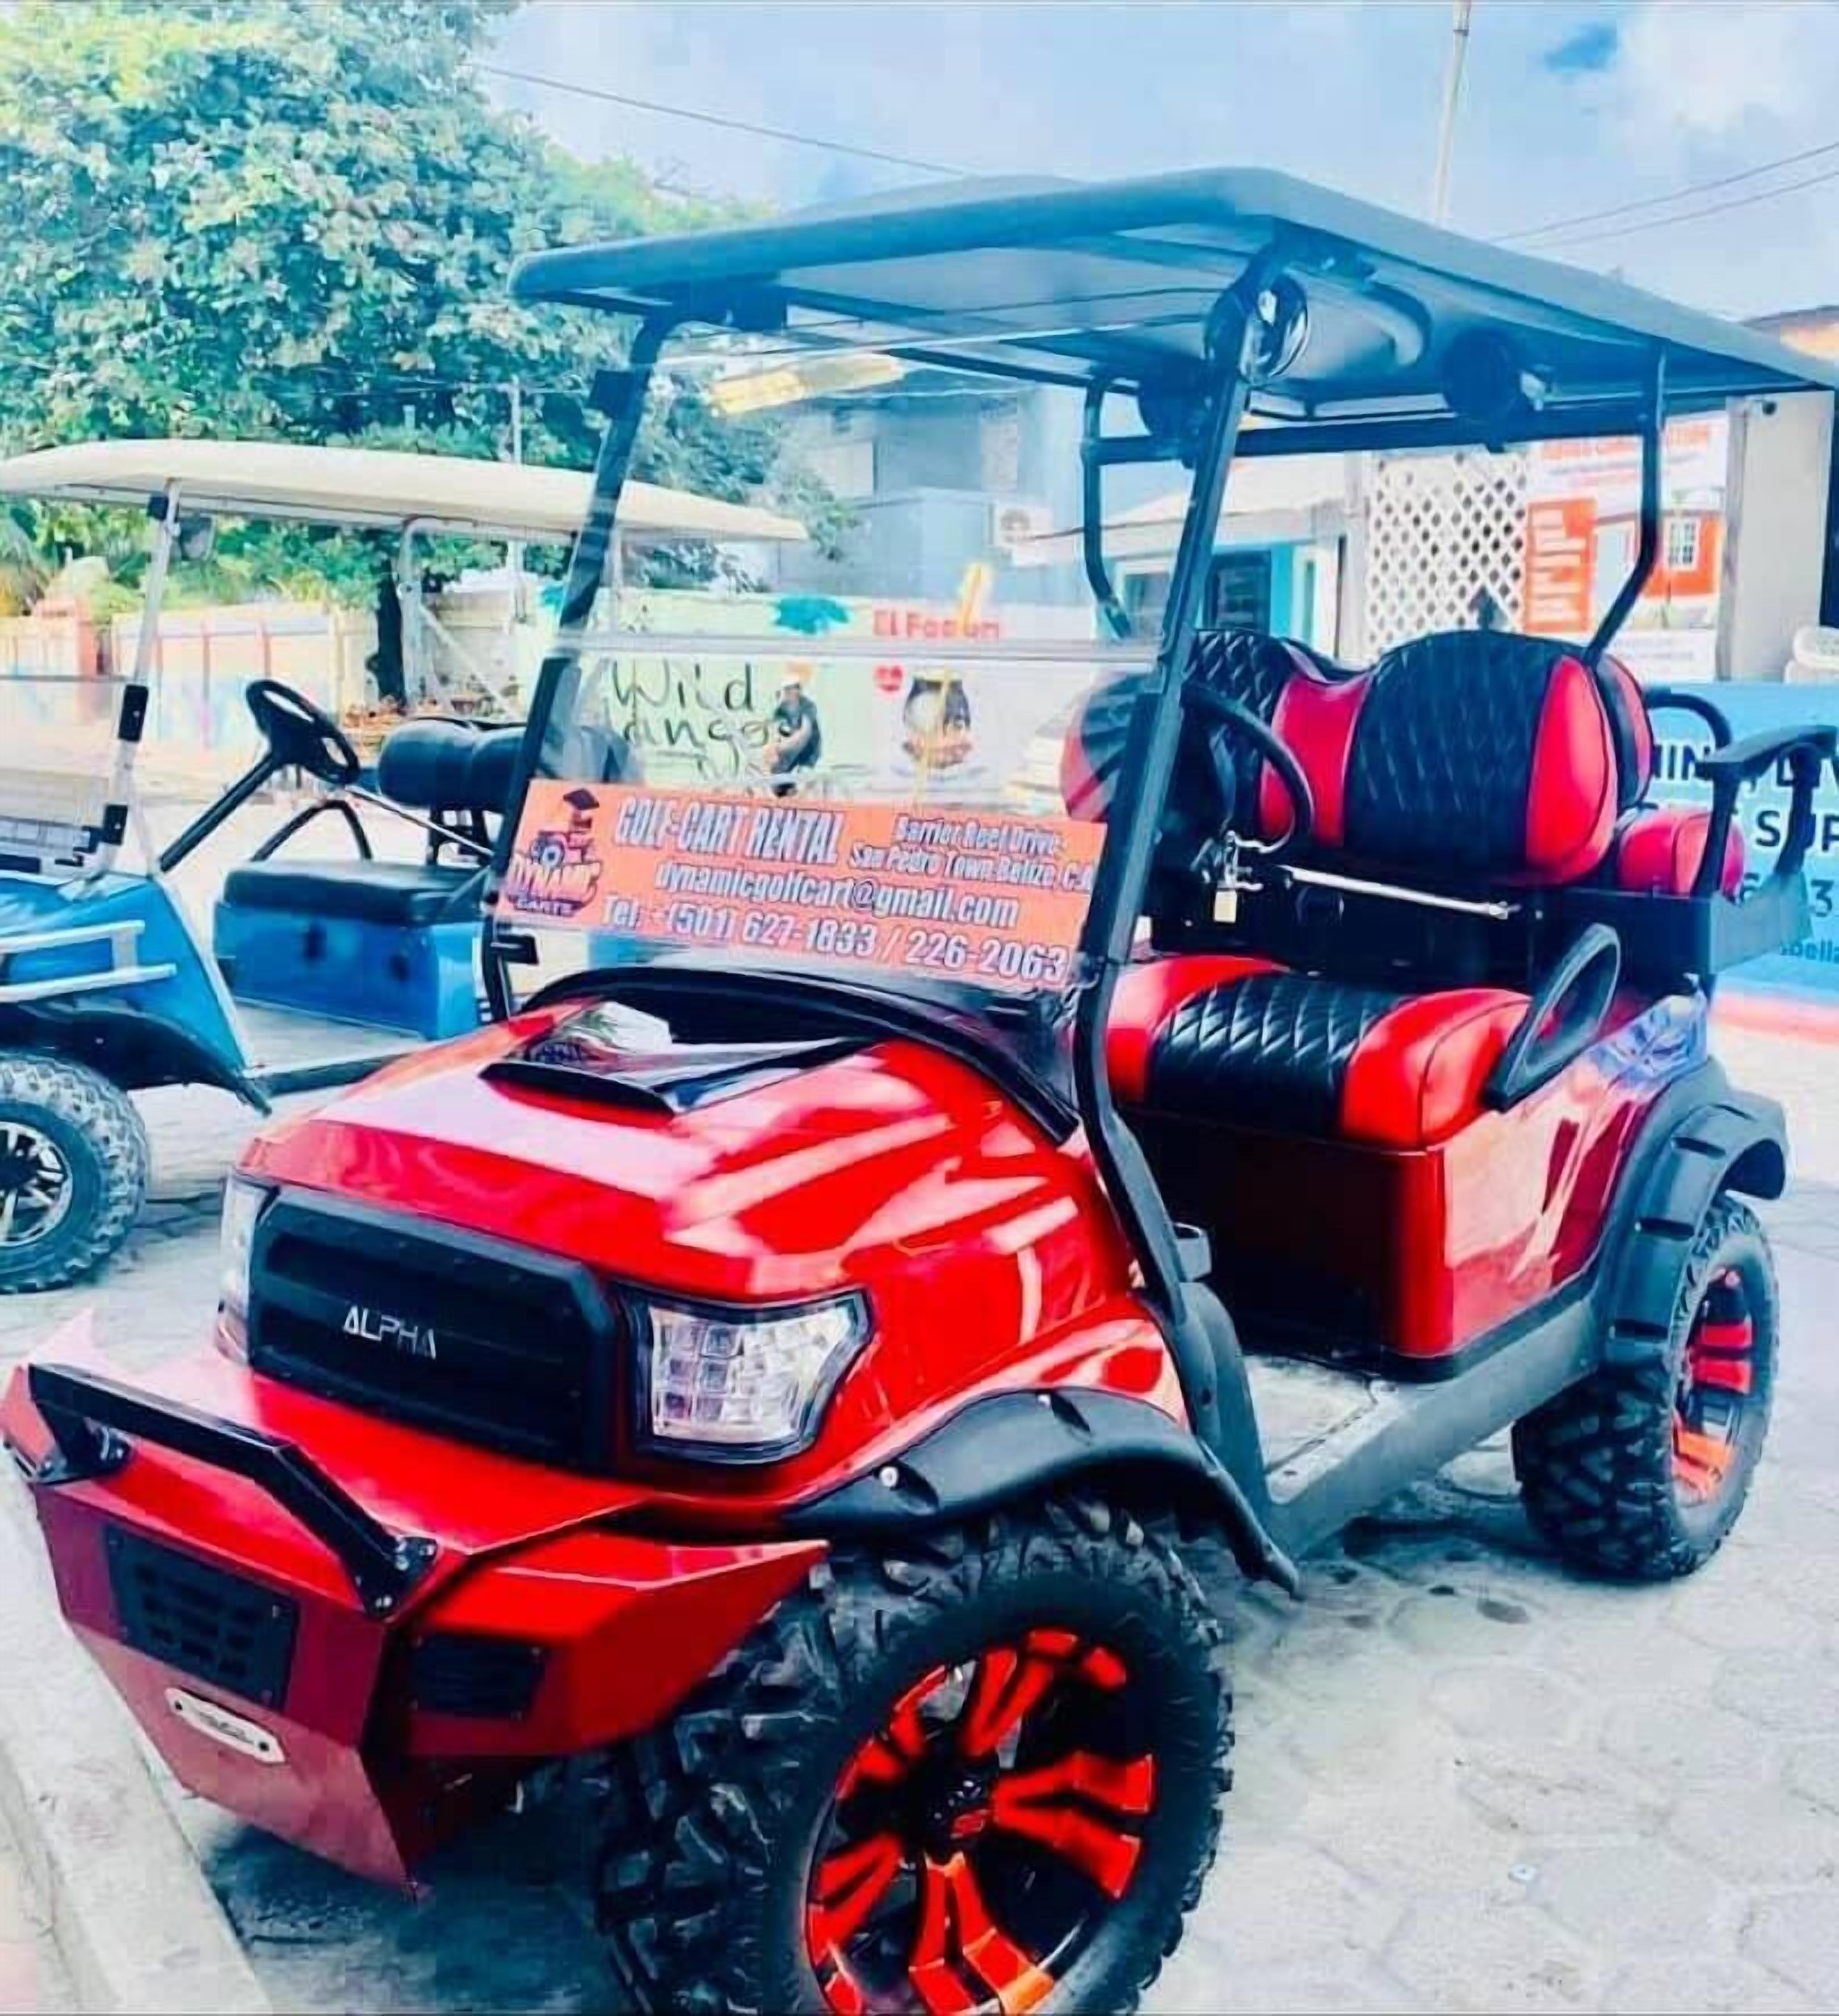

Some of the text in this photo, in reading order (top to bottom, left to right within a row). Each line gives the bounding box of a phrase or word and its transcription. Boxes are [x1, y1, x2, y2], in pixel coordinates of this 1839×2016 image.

[612, 658, 753, 711] Wild
[616, 798, 843, 863] GOLF-CART RENTAL
[669, 902, 734, 939] (501)
[742, 910, 877, 957] 627-1833
[904, 930, 1069, 982] 226-2063
[343, 1305, 436, 1360] ALPHA
